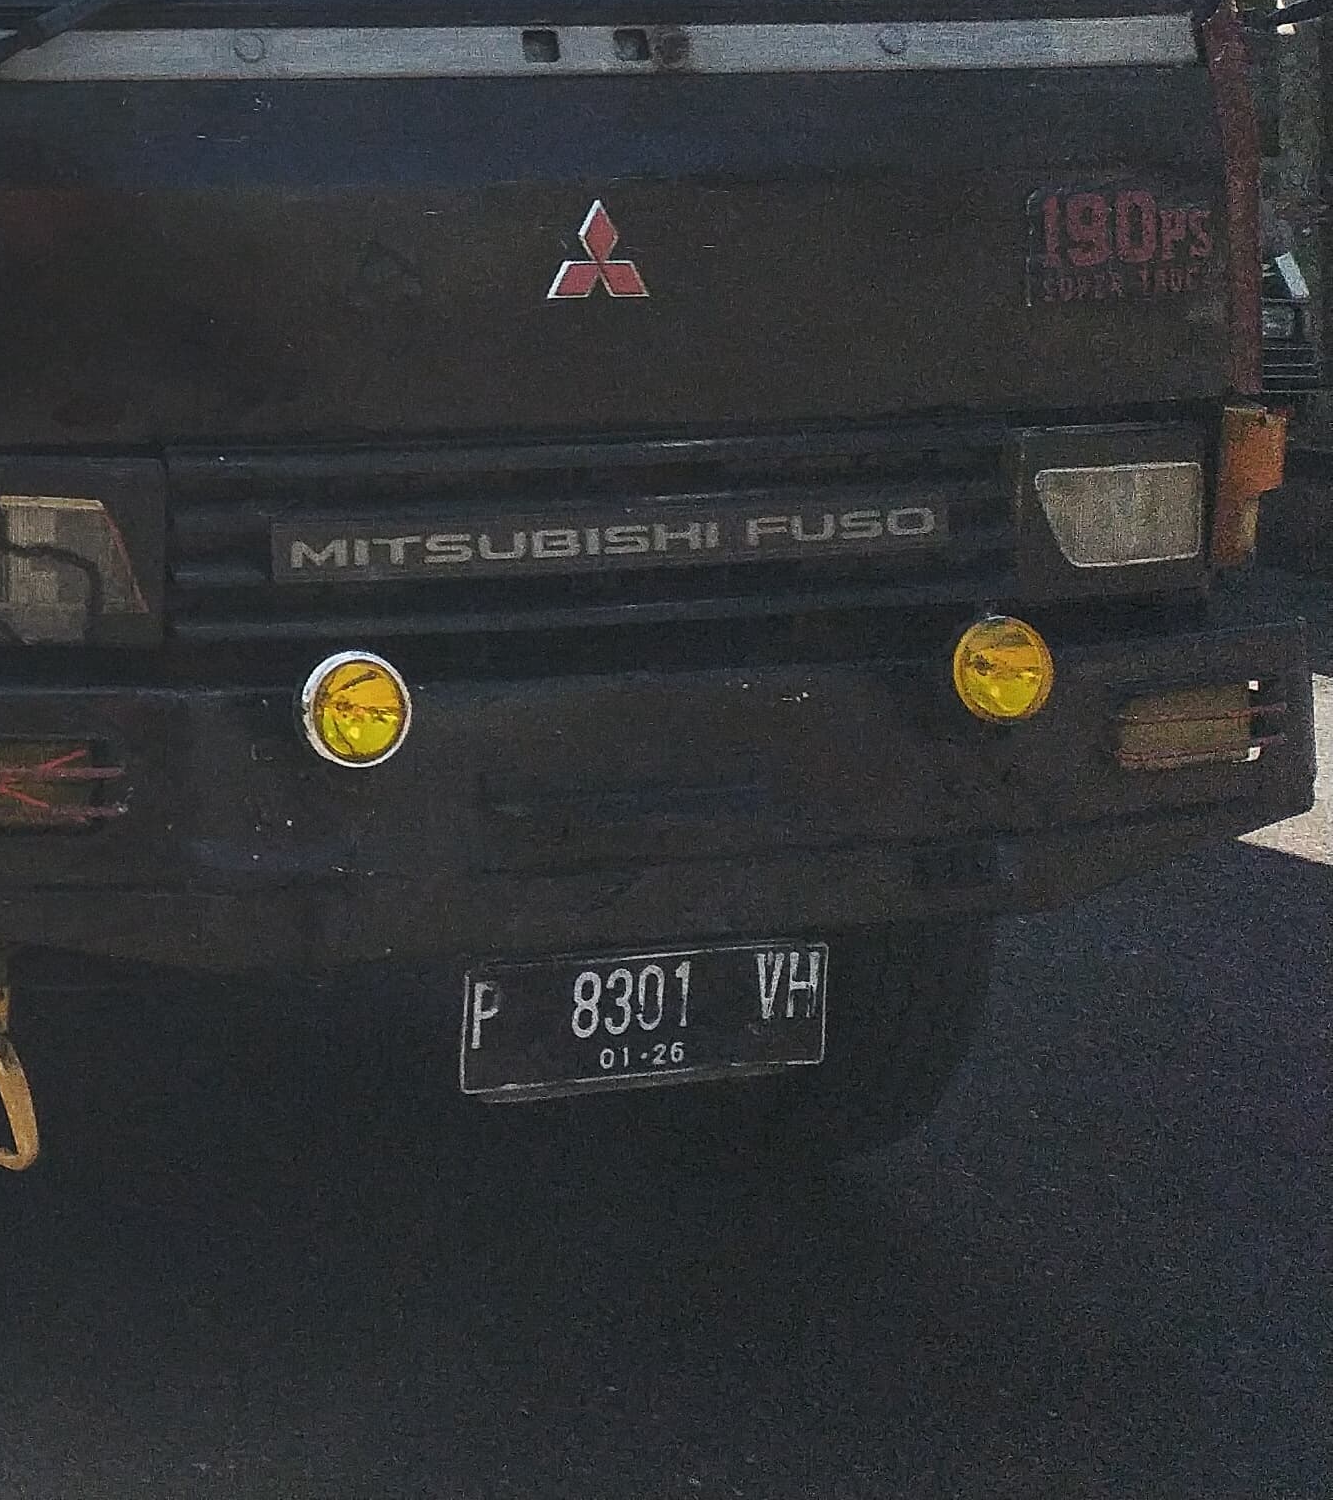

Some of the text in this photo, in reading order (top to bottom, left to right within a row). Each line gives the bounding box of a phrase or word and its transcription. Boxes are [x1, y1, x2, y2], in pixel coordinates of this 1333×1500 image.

[290, 506, 935, 569] MITSUBISHI FUSO
[471, 951, 820, 1049] P 8301 VH
